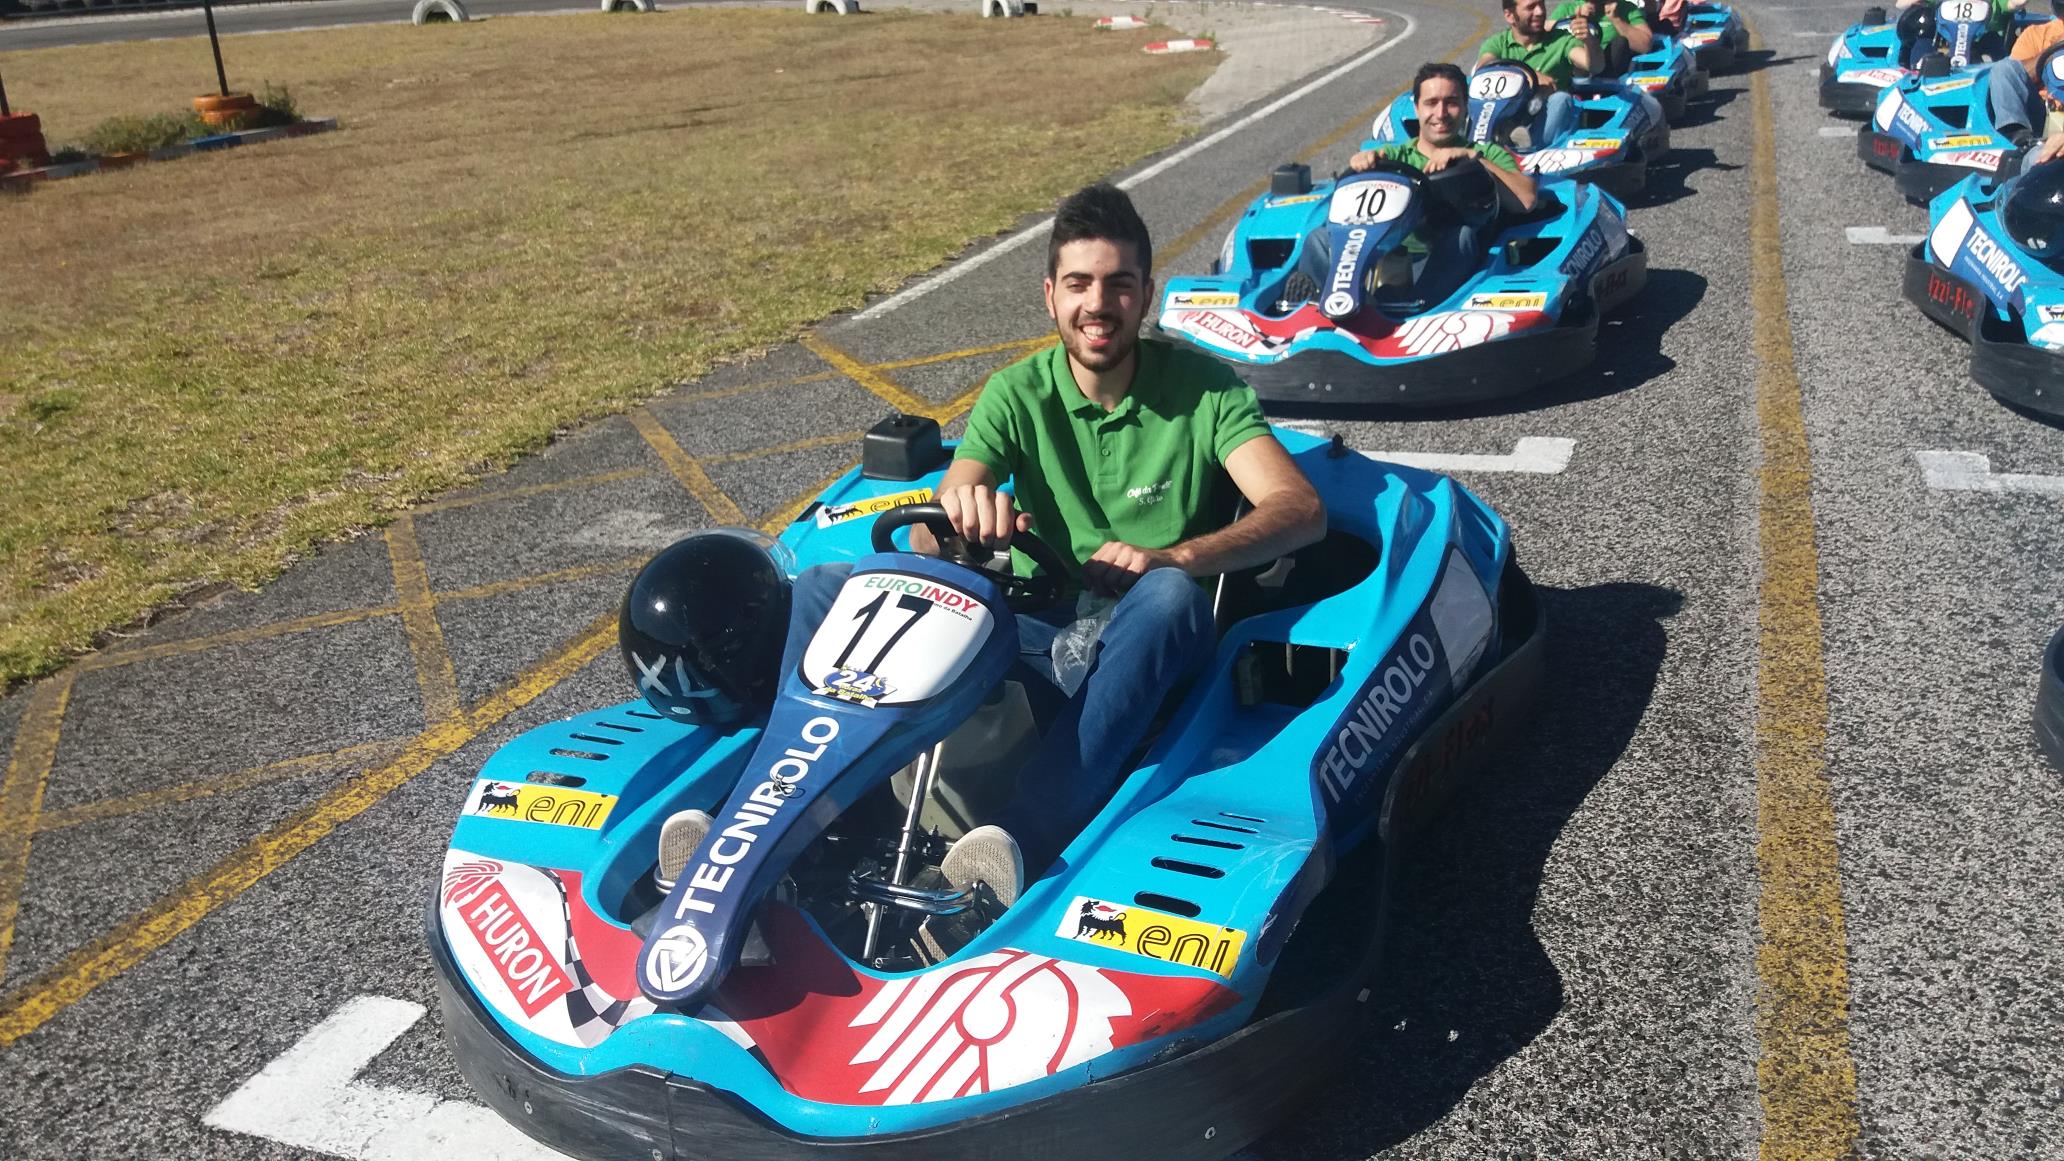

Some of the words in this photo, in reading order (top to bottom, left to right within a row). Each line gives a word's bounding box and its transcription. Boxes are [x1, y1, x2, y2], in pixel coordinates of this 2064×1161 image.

[1954, 2, 1973, 18] 18
[1479, 76, 1507, 97] 30
[1356, 188, 1387, 218] 10
[1199, 312, 1255, 348] HURON
[864, 576, 979, 613] EUROINDY
[832, 590, 935, 674] 17
[632, 651, 721, 698] XL
[831, 669, 877, 693] 24
[1319, 633, 1435, 804] TECNIROLO
[525, 793, 608, 828] eni
[674, 716, 840, 920] TECNIROLO
[470, 892, 561, 1006] HURON
[1136, 925, 1235, 974] eni
